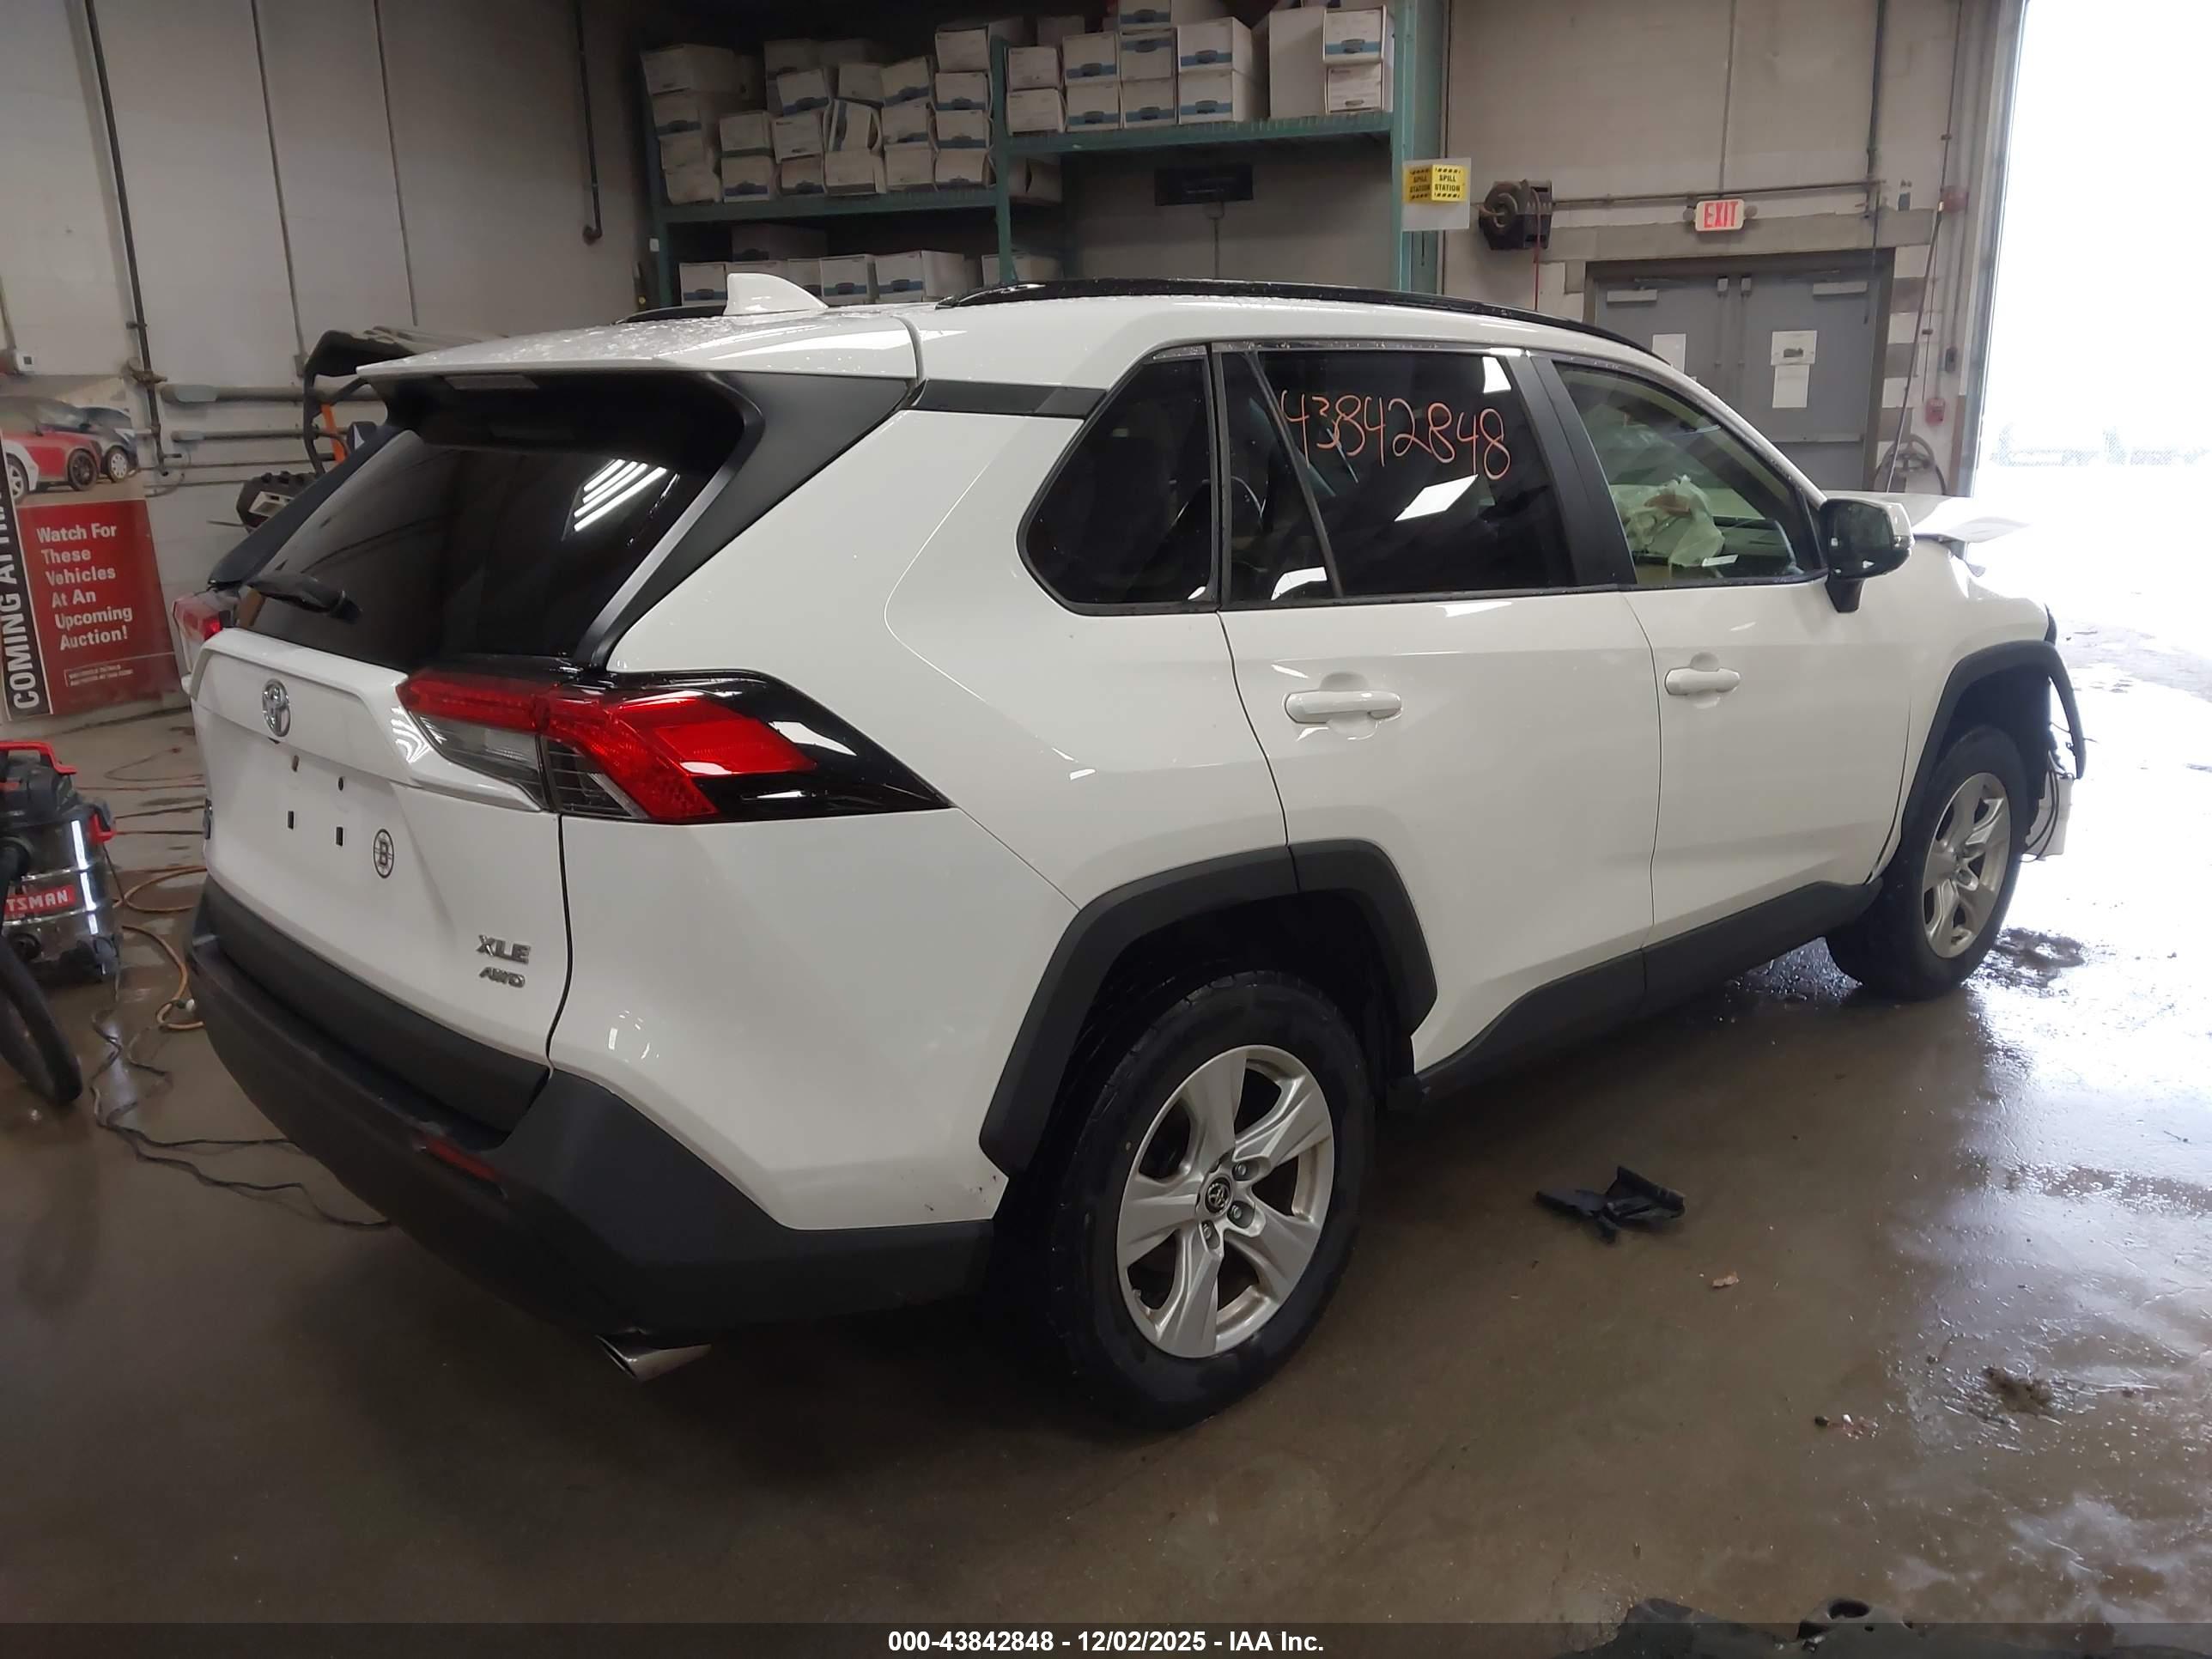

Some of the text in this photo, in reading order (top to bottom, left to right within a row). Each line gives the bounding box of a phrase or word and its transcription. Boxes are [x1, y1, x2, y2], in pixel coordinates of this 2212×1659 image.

[1704, 201, 1739, 228] EXIT
[1280, 390, 1510, 480] 43842848
[36, 523, 118, 544] Watch For
[41, 549, 92, 565] These
[46, 566, 116, 586] Vehicles
[52, 589, 96, 609] At An
[54, 606, 133, 631] Upcoming
[60, 625, 128, 651] Auction!
[0, 592, 40, 709] COMING
[6, 890, 68, 912] TSMAN
[477, 934, 531, 964] XLE
[479, 966, 526, 988] AWD
